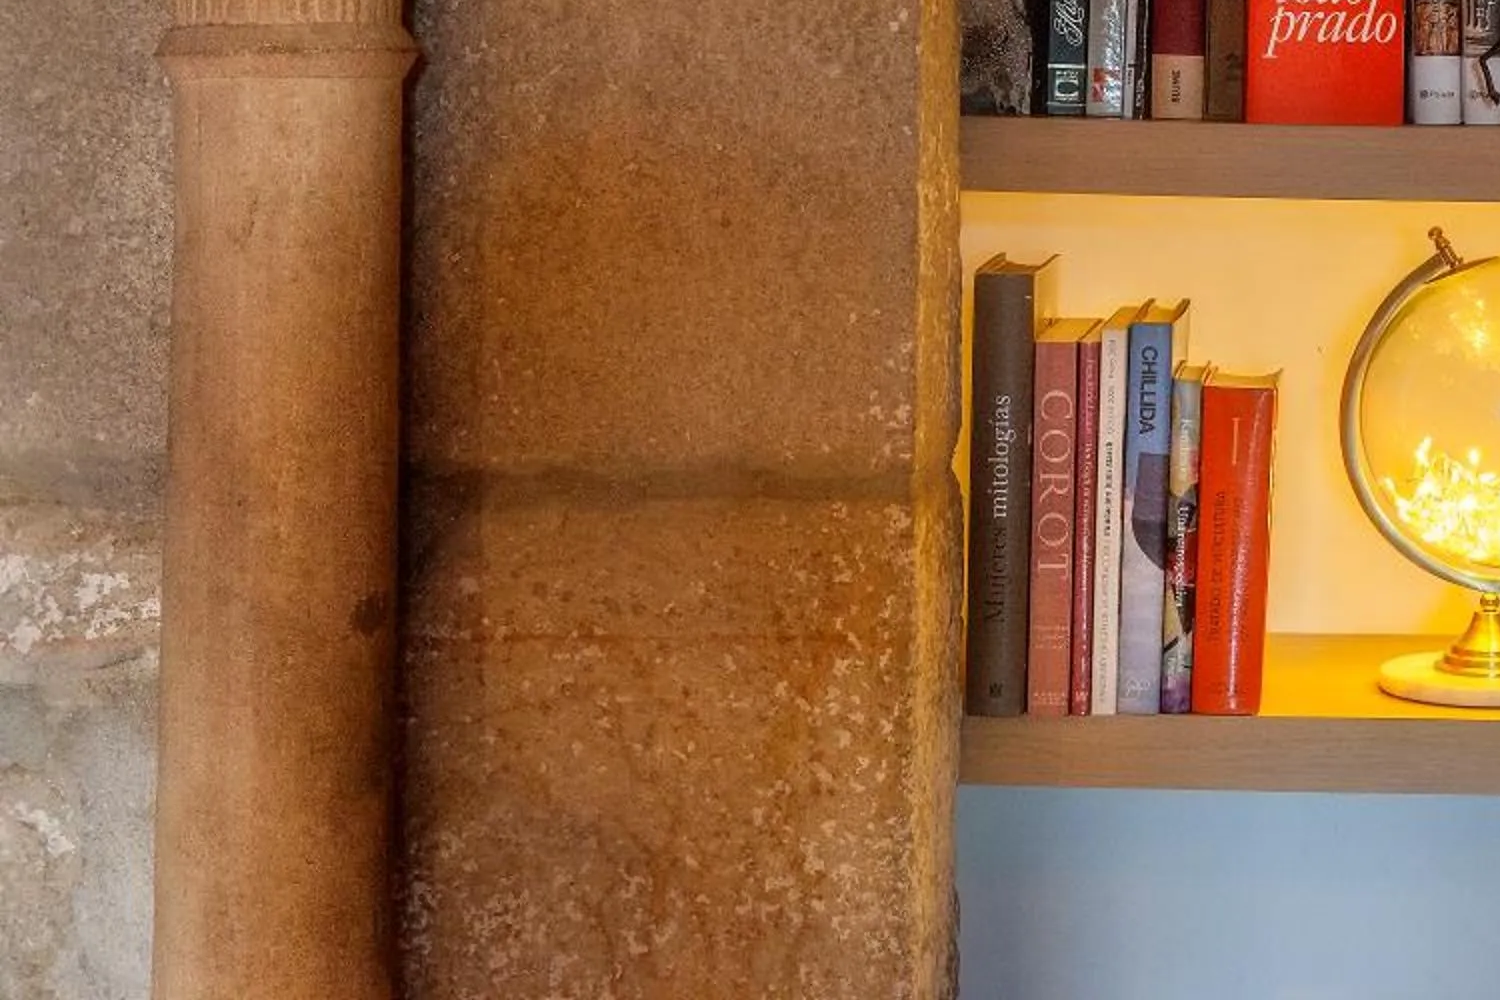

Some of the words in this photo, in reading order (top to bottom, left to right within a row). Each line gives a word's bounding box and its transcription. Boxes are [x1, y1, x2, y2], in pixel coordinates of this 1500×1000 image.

[1138, 345, 1158, 435] CHILLIDA
[987, 394, 1017, 518] mitologías
[1037, 388, 1074, 582] COROT
